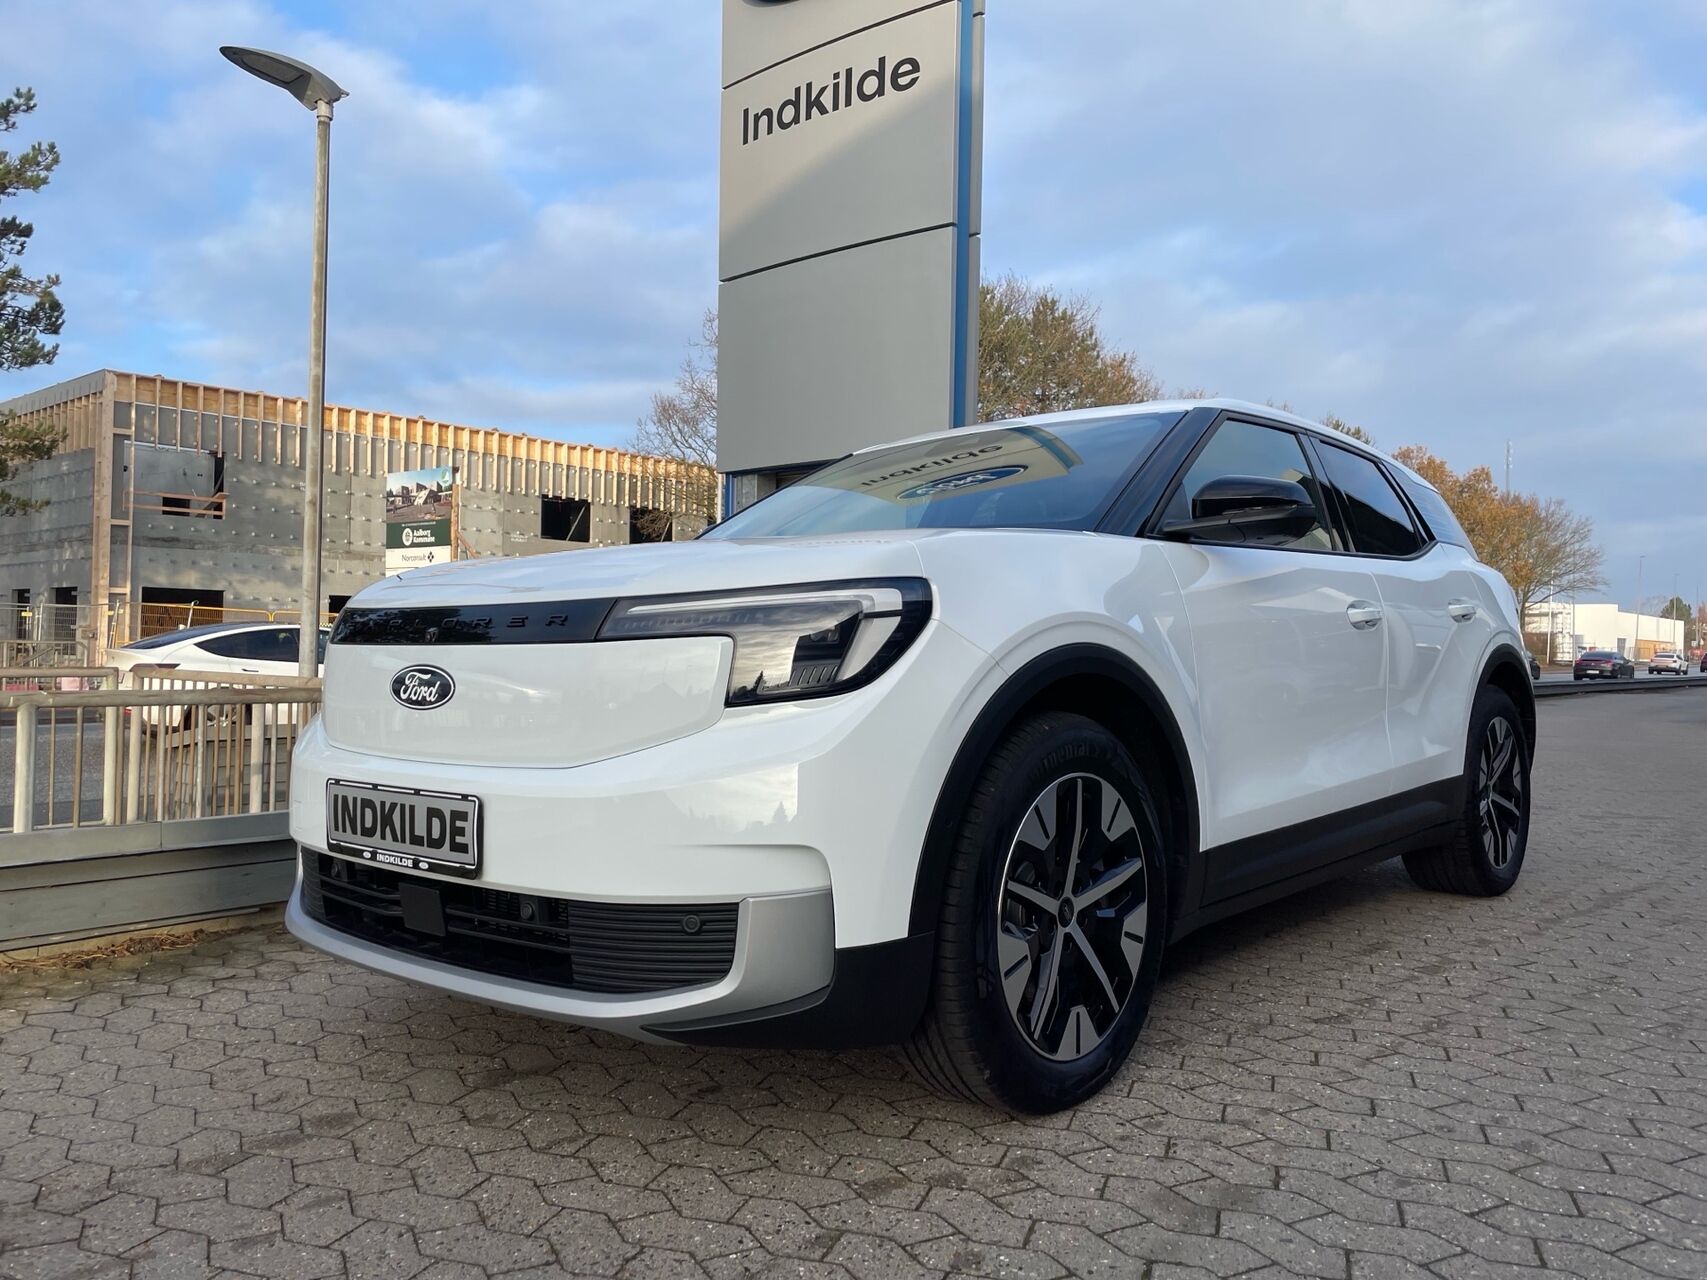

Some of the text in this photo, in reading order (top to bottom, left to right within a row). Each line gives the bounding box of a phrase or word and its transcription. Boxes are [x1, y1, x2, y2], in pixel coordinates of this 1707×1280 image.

[742, 55, 921, 146] Indkilde
[413, 529, 431, 537] Aalborg
[400, 671, 441, 702] Ford
[333, 793, 469, 855] INDKILDE
[376, 853, 414, 868] INDKILDE
